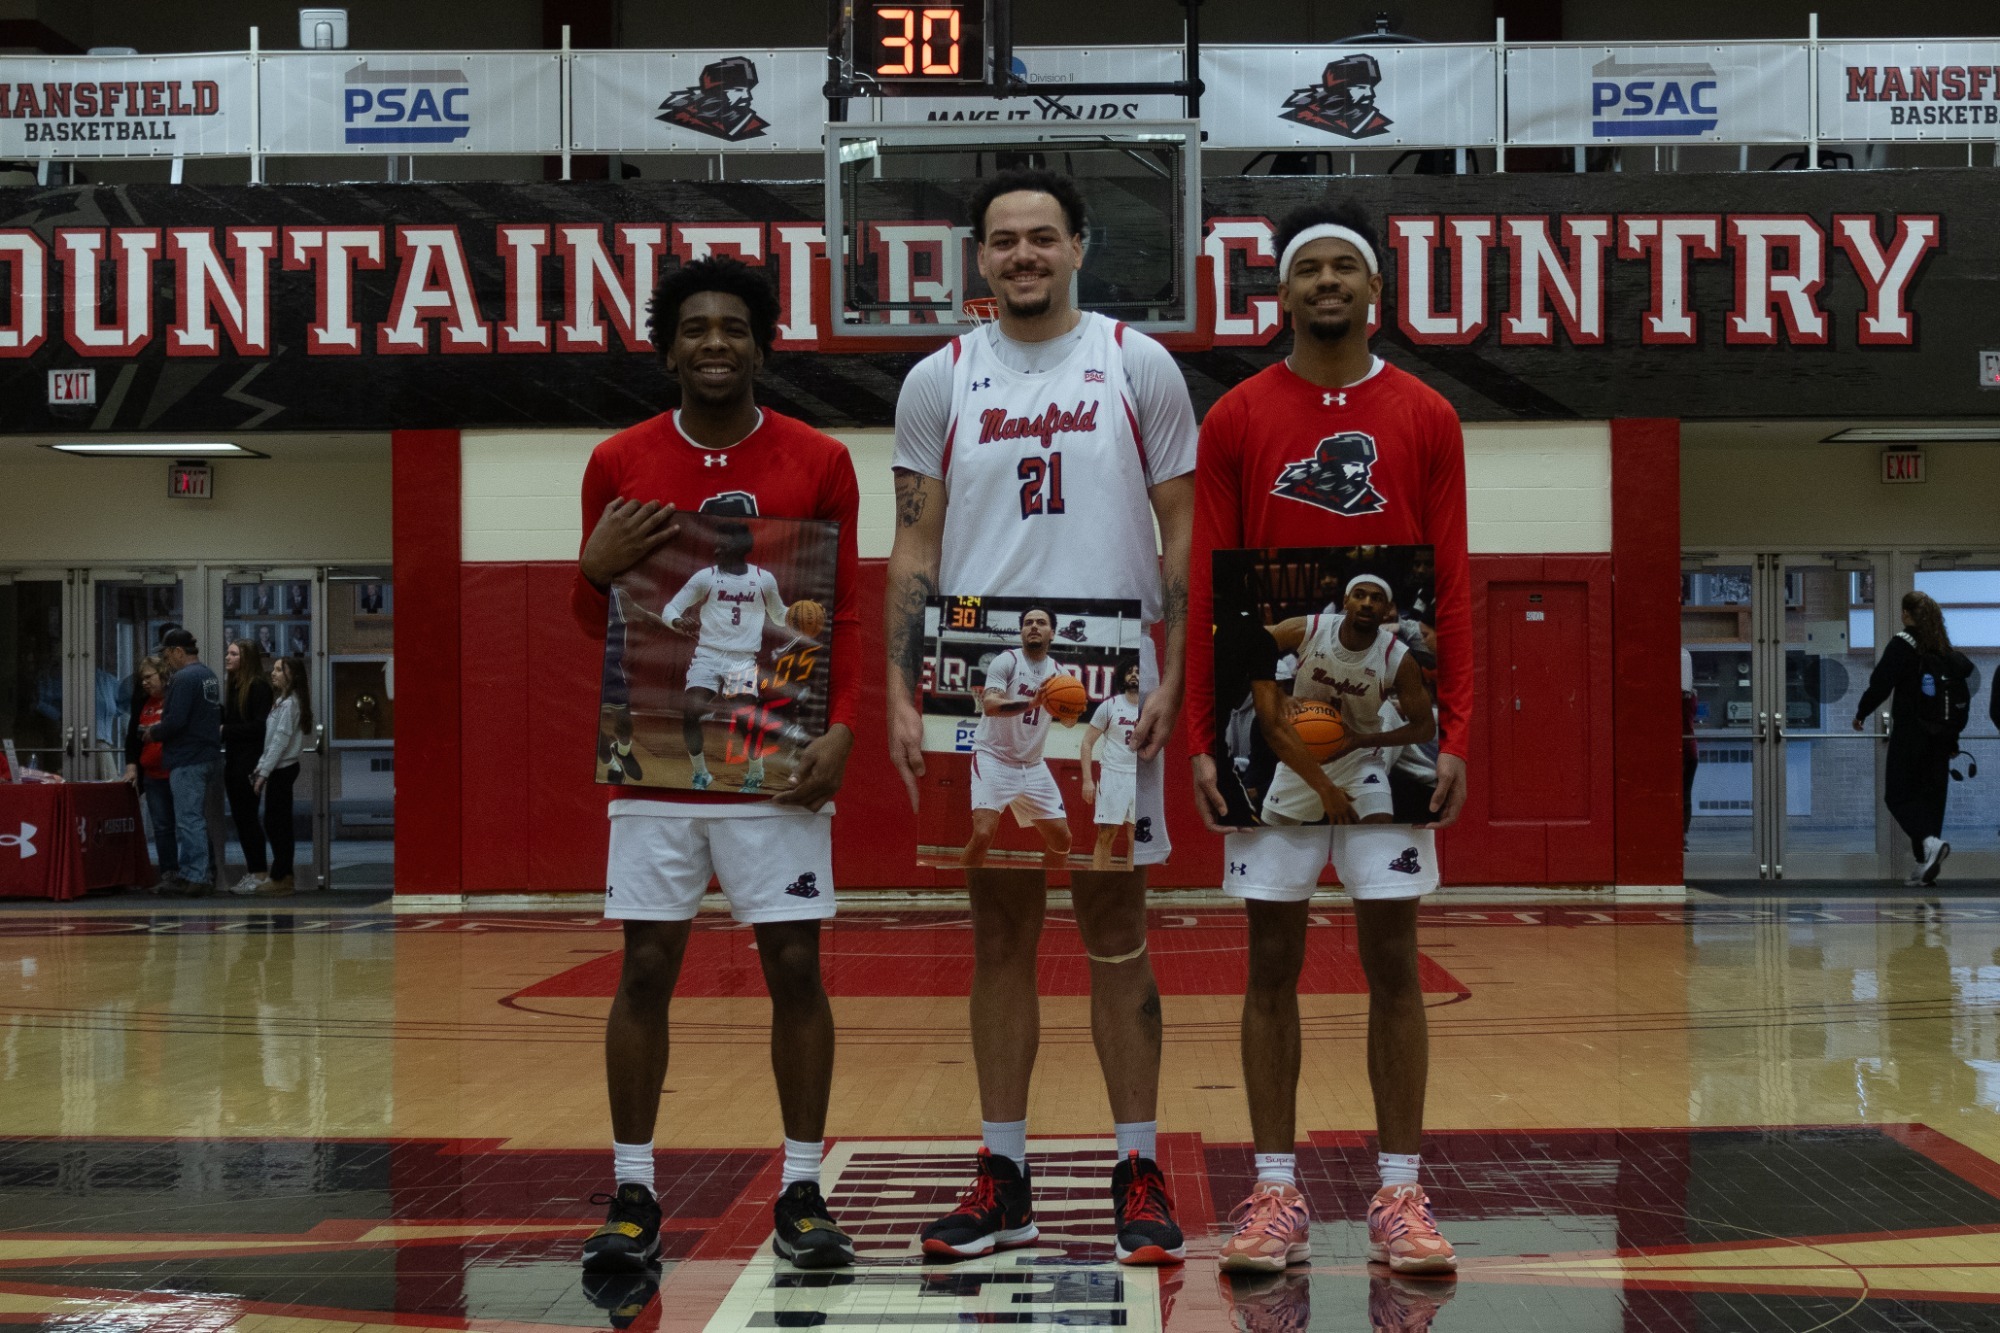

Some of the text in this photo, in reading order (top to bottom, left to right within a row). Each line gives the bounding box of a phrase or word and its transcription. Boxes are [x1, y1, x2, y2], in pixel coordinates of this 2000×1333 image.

[877, 9, 960, 74] 30
[1030, 73, 1066, 82] Division
[345, 88, 470, 122] PSAC
[1592, 82, 1718, 116] PSAC
[1891, 105, 2000, 124] BASKETB
[25, 121, 176, 142] BASKETBALL
[1202, 214, 1940, 346] CUNTRY
[54, 373, 90, 400] EXIT
[978, 400, 1099, 449] Mansfield
[1886, 454, 1921, 480] EXIT
[174, 469, 207, 494] EXIT
[1017, 452, 1065, 520] 21
[731, 606, 741, 626] 3
[951, 607, 977, 628] 30
